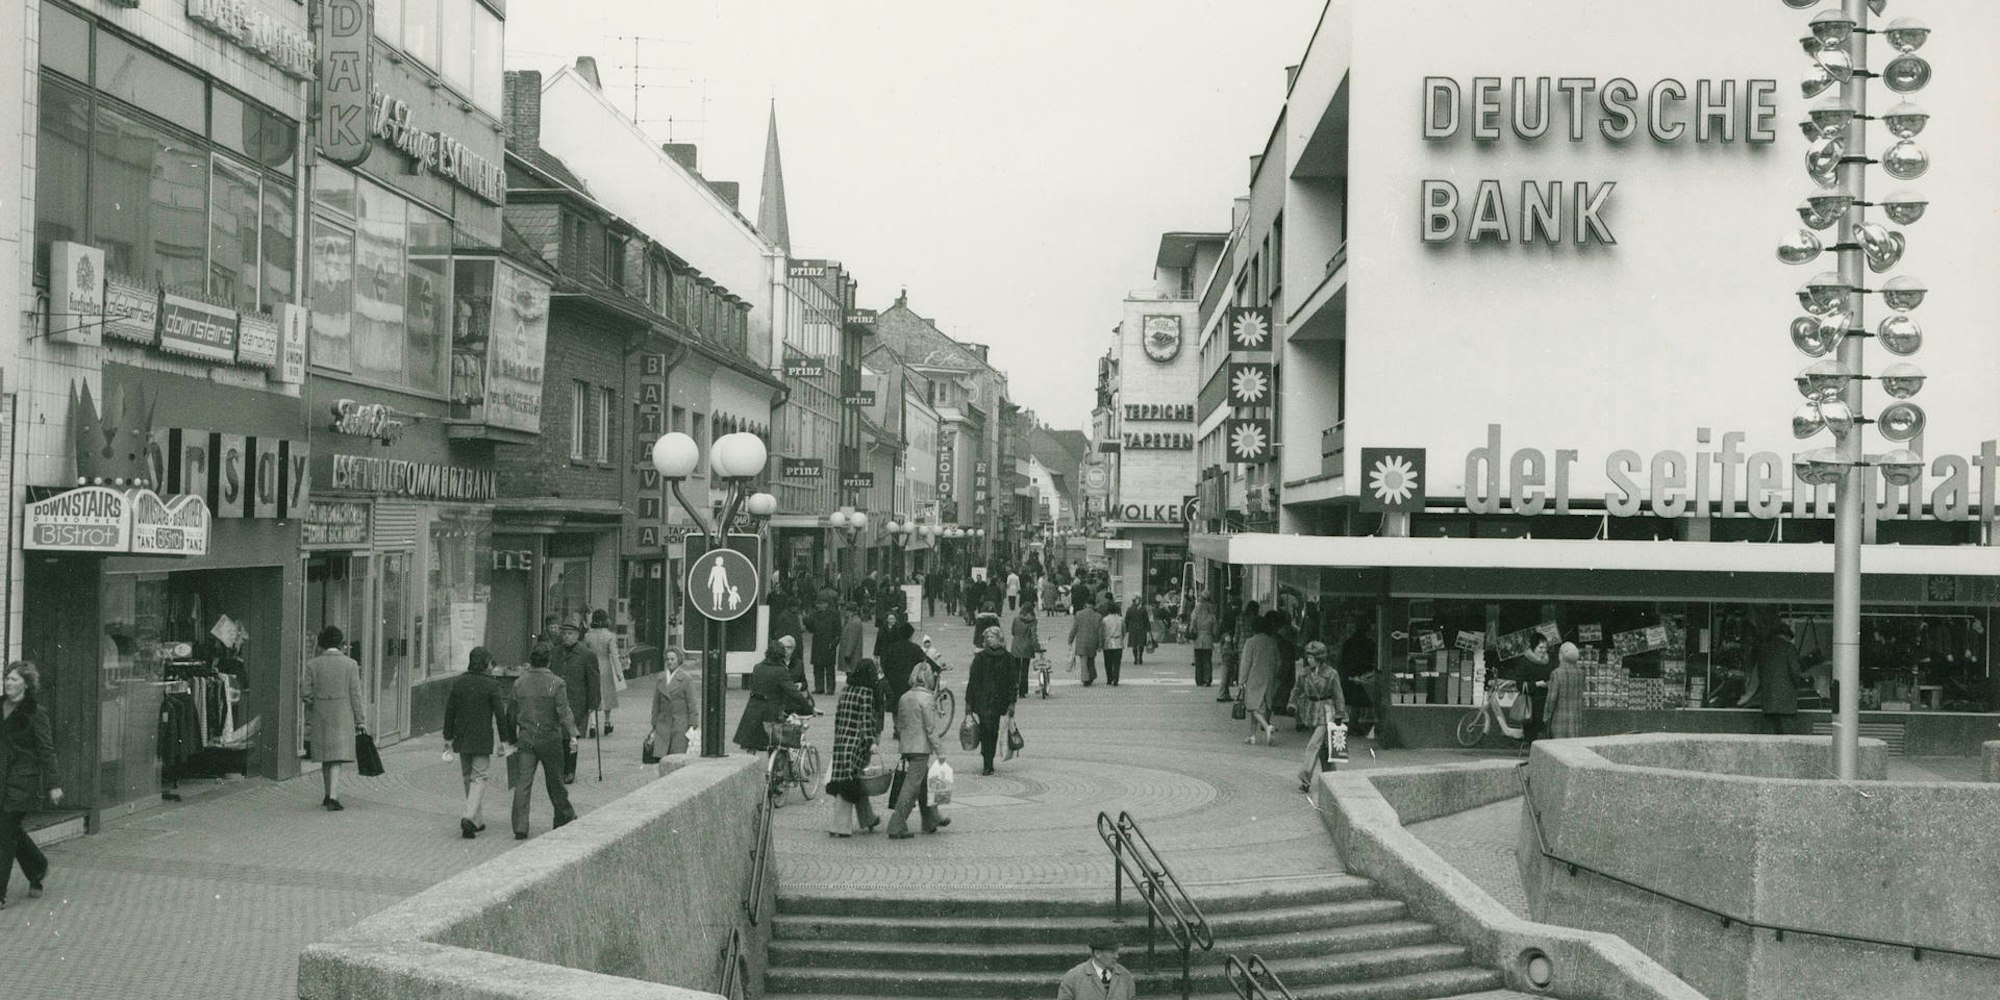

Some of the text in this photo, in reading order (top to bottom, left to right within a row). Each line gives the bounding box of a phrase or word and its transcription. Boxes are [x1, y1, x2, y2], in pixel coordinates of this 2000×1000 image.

[1422, 76, 1777, 143] DEUTSCHE
[1421, 180, 1617, 245] BANK
[165, 305, 233, 345] downstairs
[1124, 404, 1194, 420] TEPPICHE
[1124, 433, 1193, 449] TAPETEN
[938, 453, 951, 492] FOTO
[1465, 423, 1578, 515] der
[35, 490, 121, 517] DOWNSTAIRS
[138, 536, 155, 549] TANZ
[186, 538, 202, 552] TANZ
